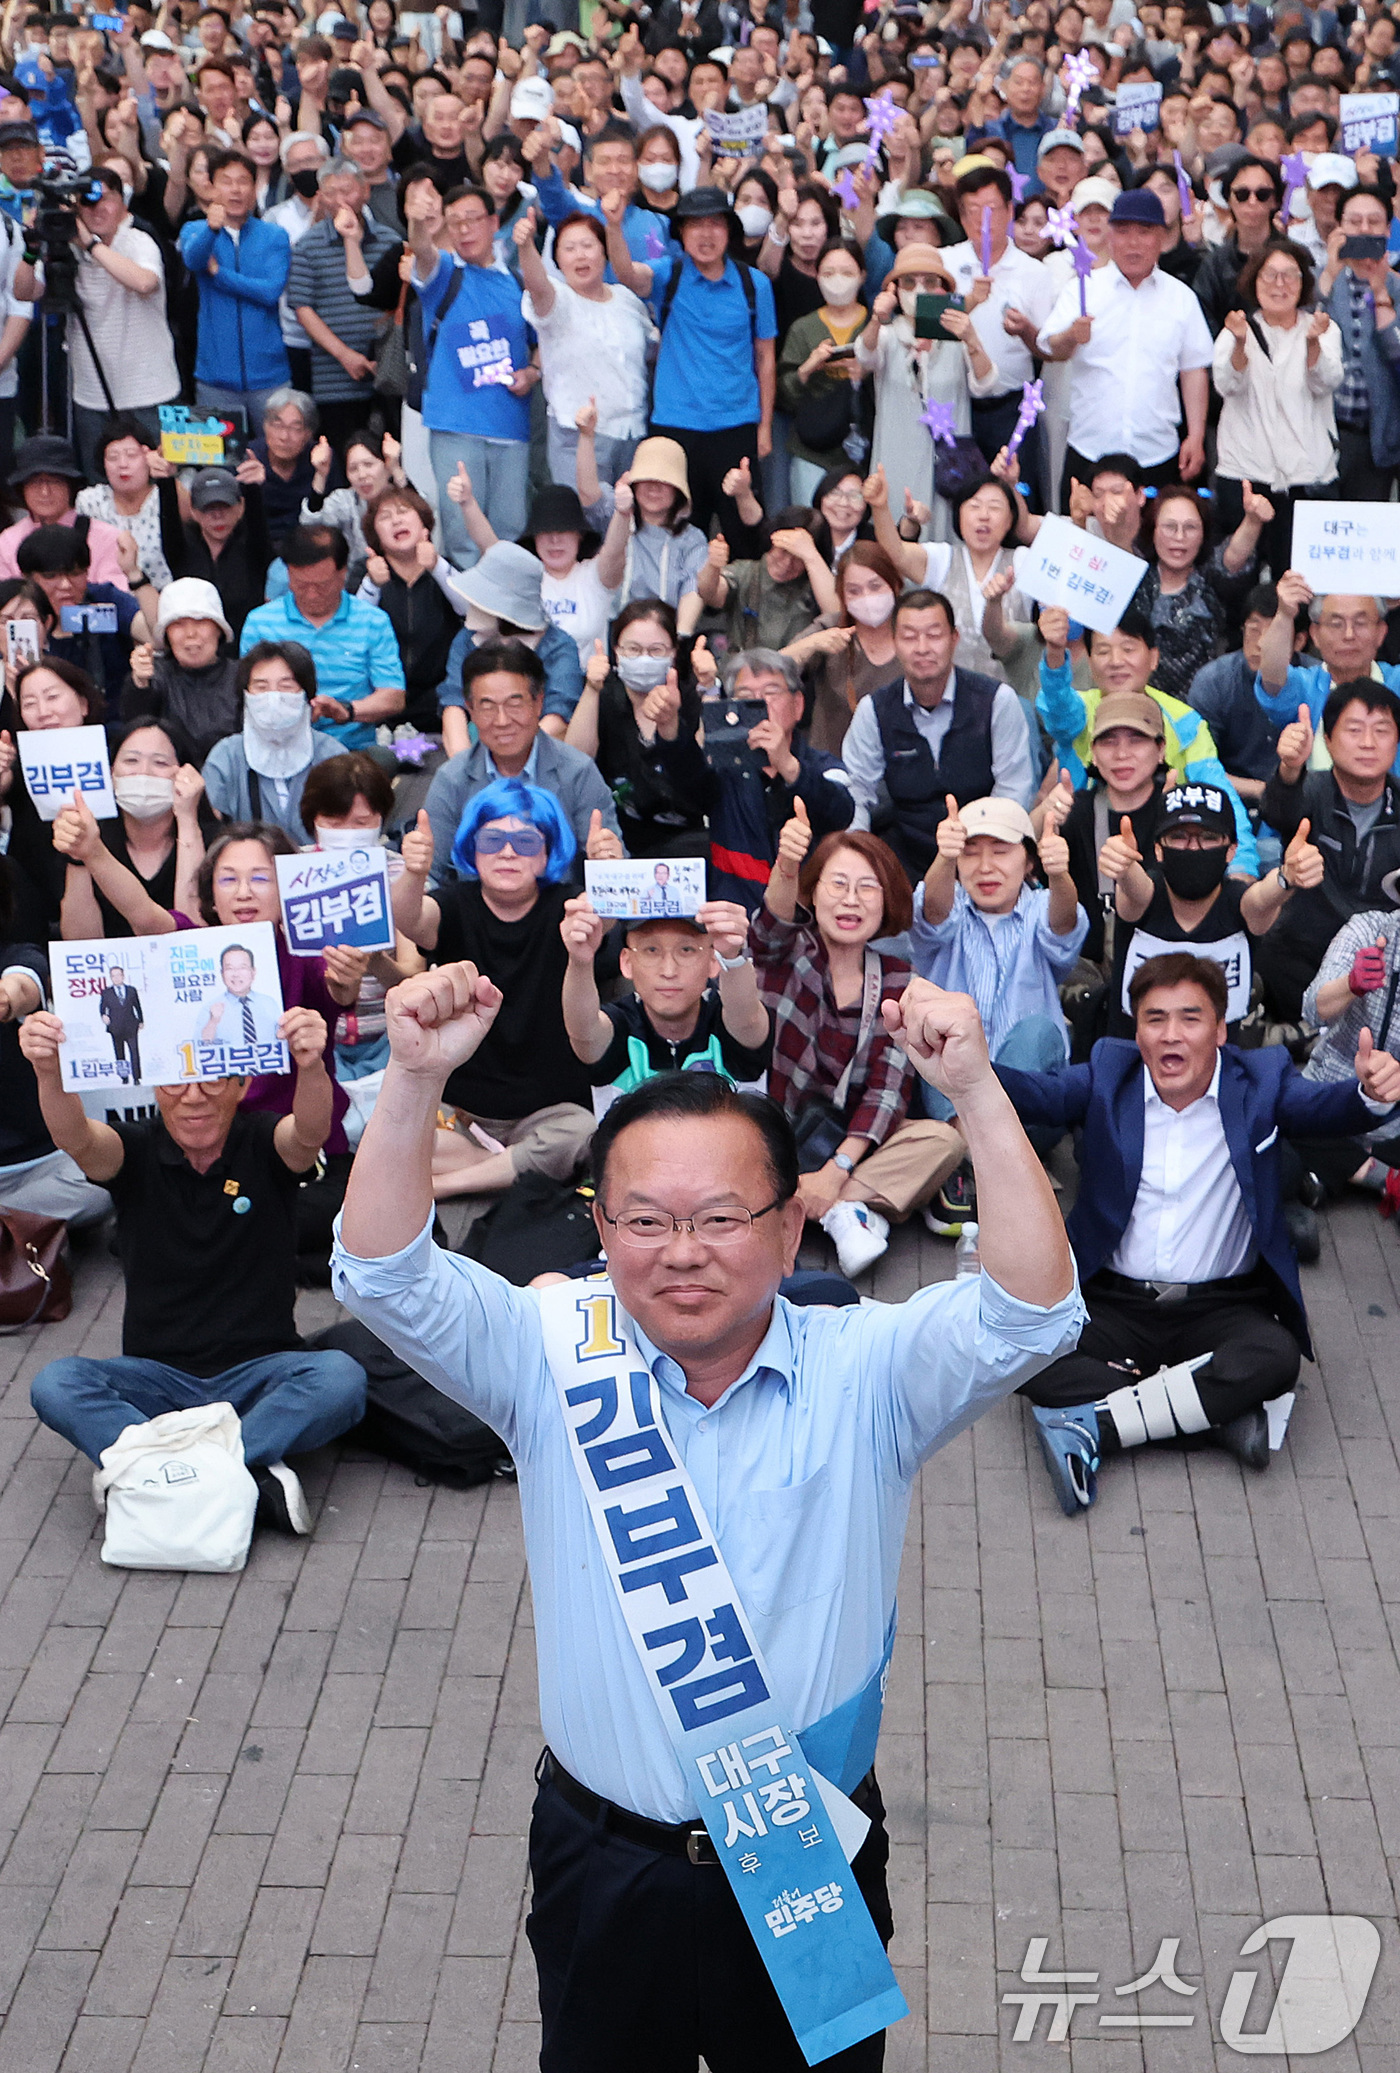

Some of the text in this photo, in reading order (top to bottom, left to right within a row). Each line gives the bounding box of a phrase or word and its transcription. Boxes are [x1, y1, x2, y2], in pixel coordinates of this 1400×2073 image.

[26, 761, 105, 795] 김부겸
[289, 860, 347, 888] 시장은
[290, 880, 384, 941] 김부겸
[640, 900, 680, 914] 김부겸
[170, 944, 198, 959] 지금
[171, 958, 214, 974] 대구에
[173, 974, 216, 989] 필요한
[175, 989, 203, 1003] 사람
[199, 1042, 284, 1075] 김부겸
[576, 1294, 626, 1363] 1
[566, 1371, 771, 1732] 김부겸
[695, 1724, 793, 1798] 대구
[722, 1773, 811, 1848] 시장
[764, 1881, 844, 1938] 민주당
[771, 1887, 801, 1908] 더불어
